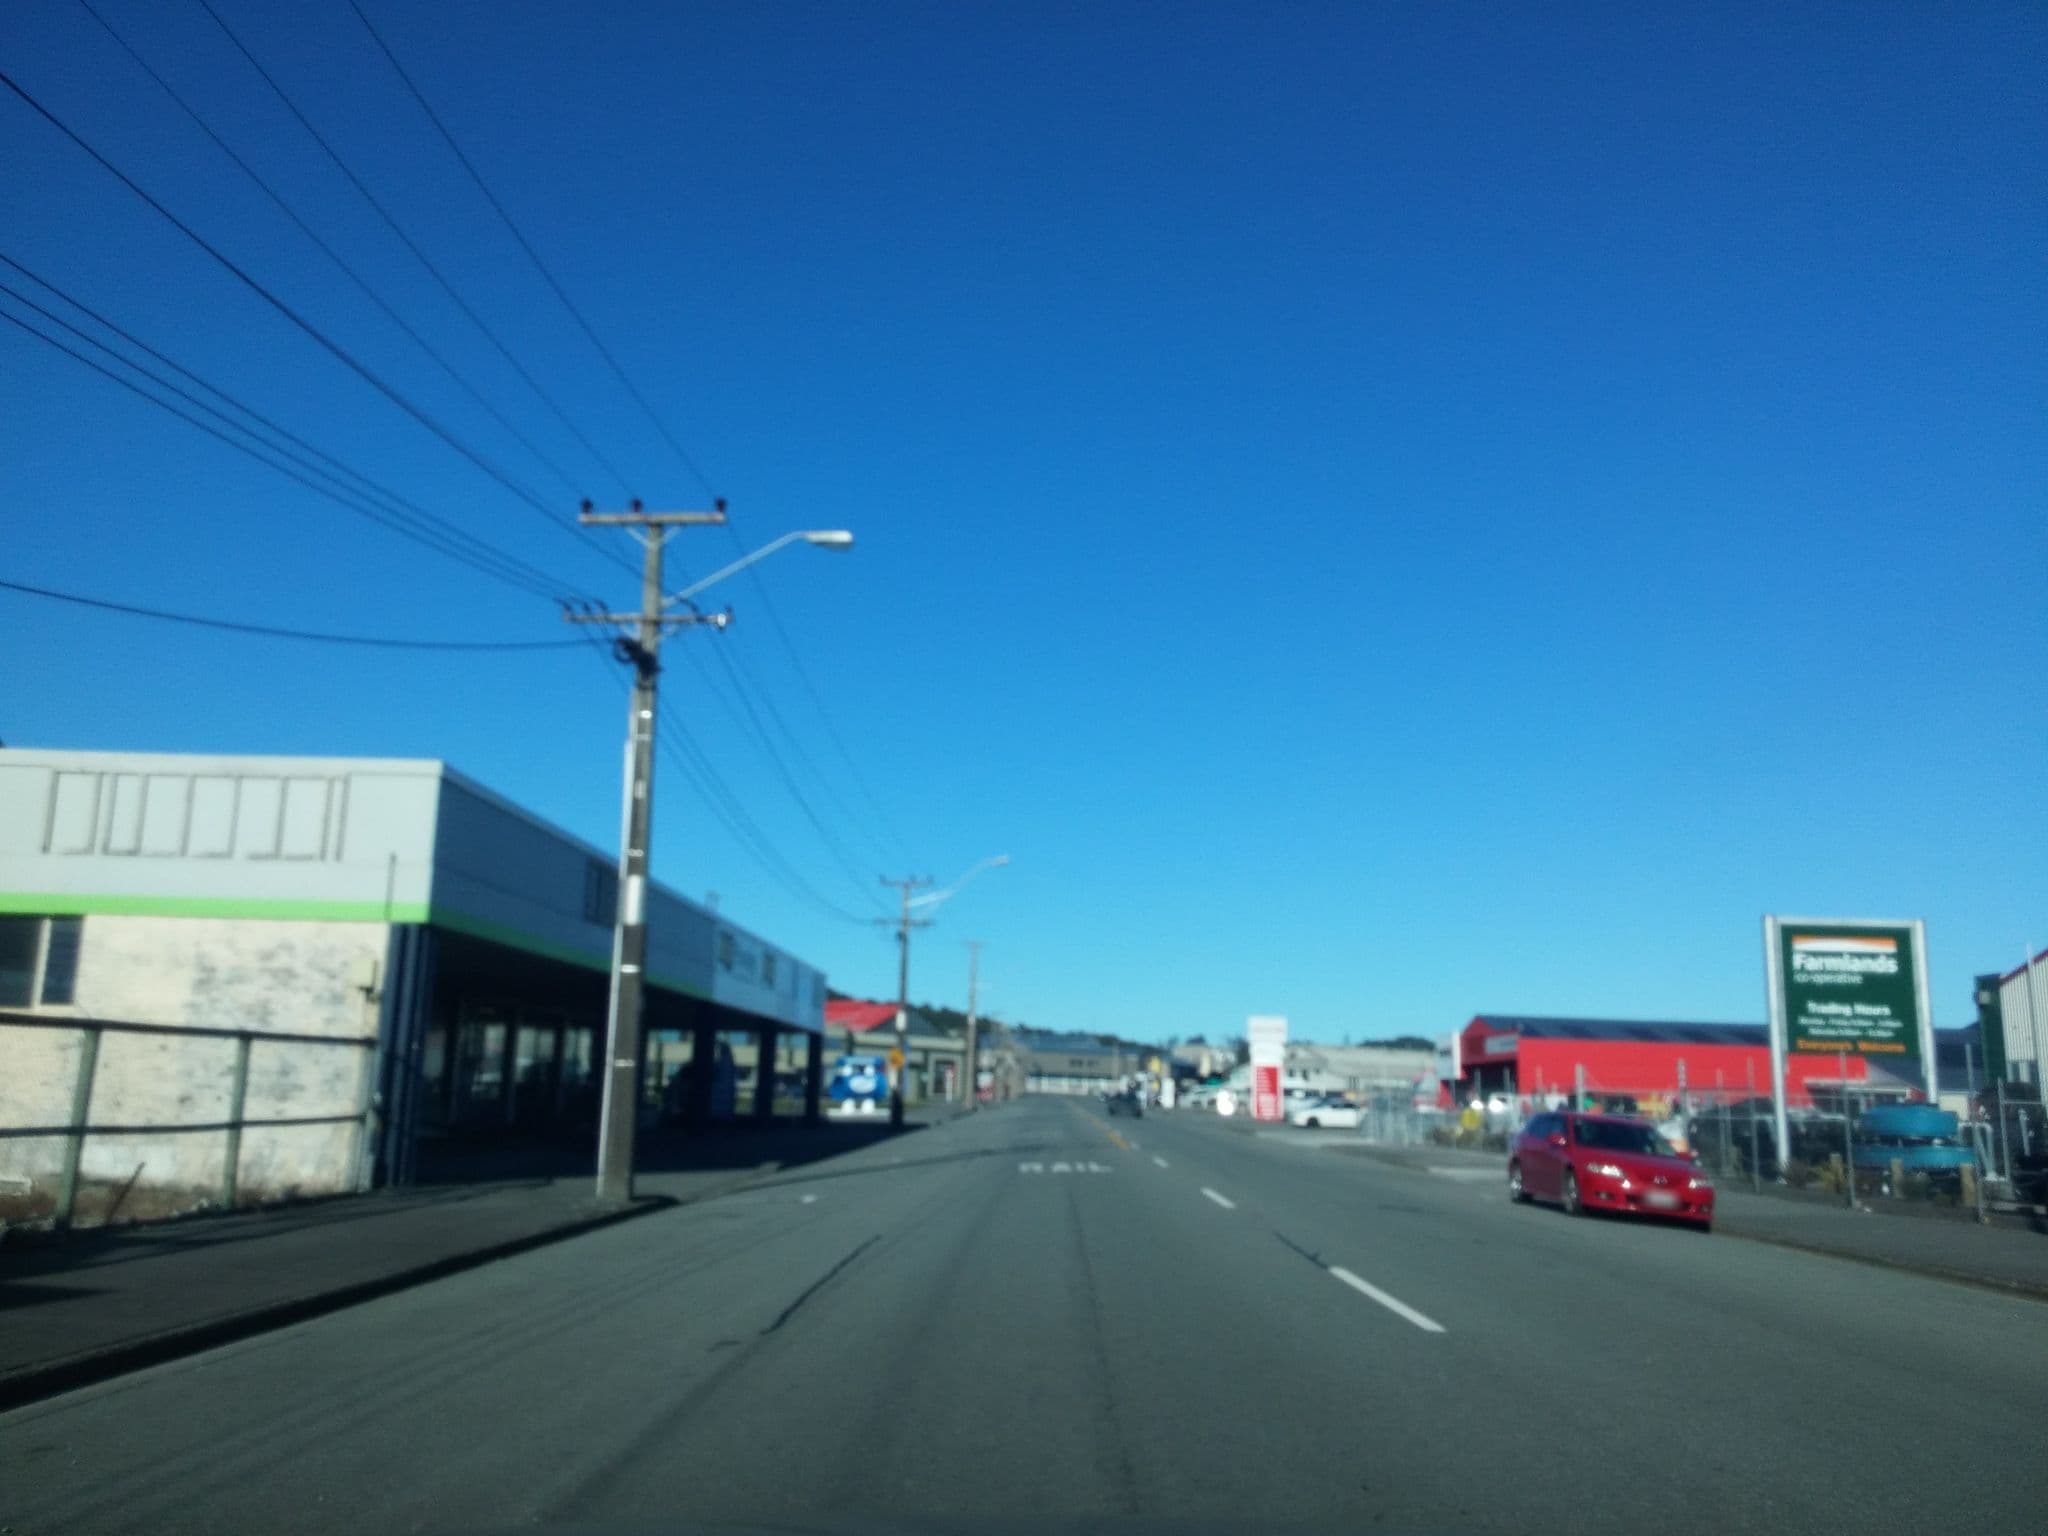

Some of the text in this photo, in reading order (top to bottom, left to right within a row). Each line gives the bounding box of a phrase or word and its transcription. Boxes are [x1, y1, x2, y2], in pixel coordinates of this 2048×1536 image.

[1792, 952, 1898, 973] Farmlands
[1807, 1002, 1891, 1016] Trading Hours
